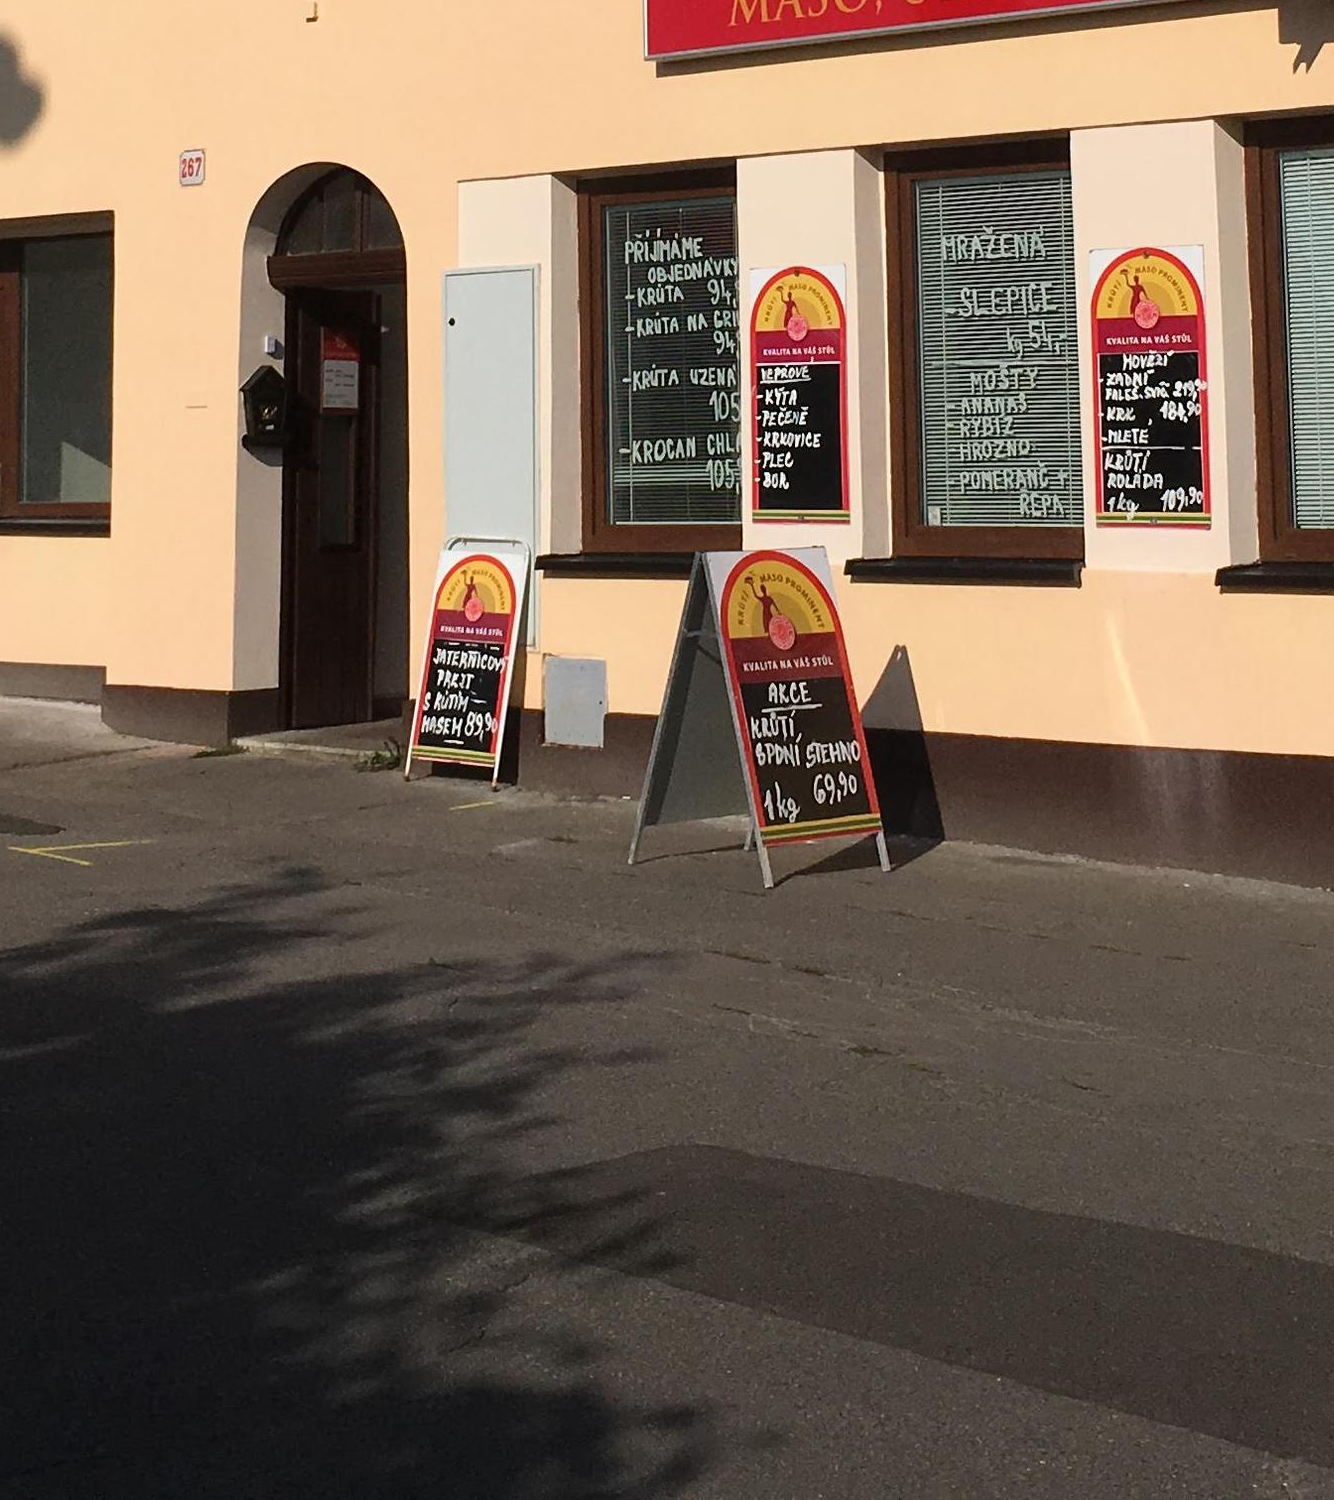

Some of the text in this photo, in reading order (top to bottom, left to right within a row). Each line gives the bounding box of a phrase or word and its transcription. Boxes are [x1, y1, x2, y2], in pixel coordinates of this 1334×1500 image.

[181, 156, 202, 179] 267
[687, 312, 708, 332] NA
[1106, 336, 1138, 346] KVALITA
[1140, 336, 1152, 345] NA
[759, 572, 784, 583] MASO
[785, 577, 825, 629] PROMINENT
[742, 654, 834, 672] KVALITA NA VÁŠ STŮL
[768, 681, 812, 705] AKCE
[805, 740, 861, 769] STEHNO
